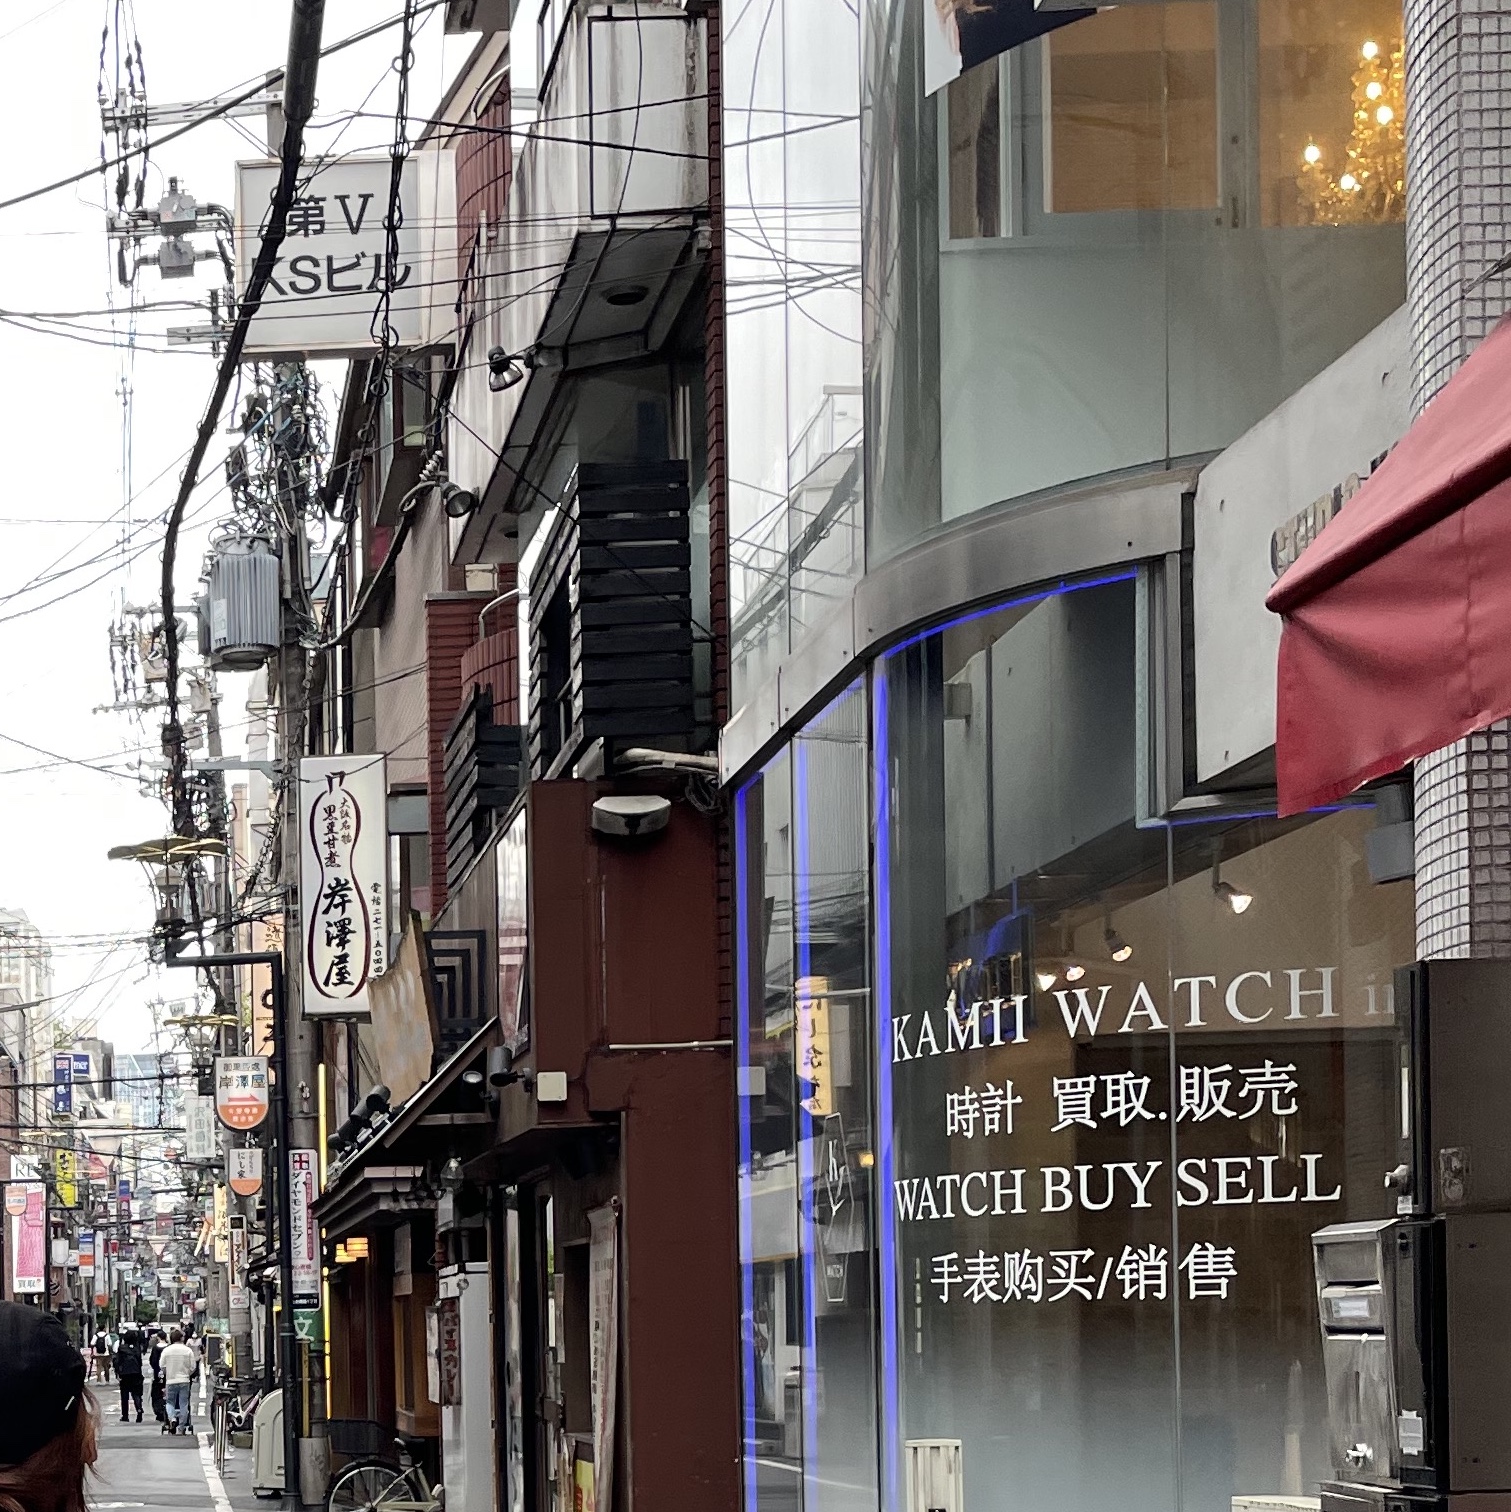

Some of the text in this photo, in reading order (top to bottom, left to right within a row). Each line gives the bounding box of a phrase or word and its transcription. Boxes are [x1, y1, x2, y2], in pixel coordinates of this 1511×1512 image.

[322, 804, 342, 868] 黒豆甘煮
[322, 877, 357, 987] 岸澤屋
[892, 994, 1029, 1063] KAMII
[1052, 966, 1339, 1039] WATCH
[945, 1079, 1023, 1139] 時計
[894, 1153, 1343, 1222] WATCH BUY SELL
[930, 1242, 1238, 1304] 手表购买/销售
